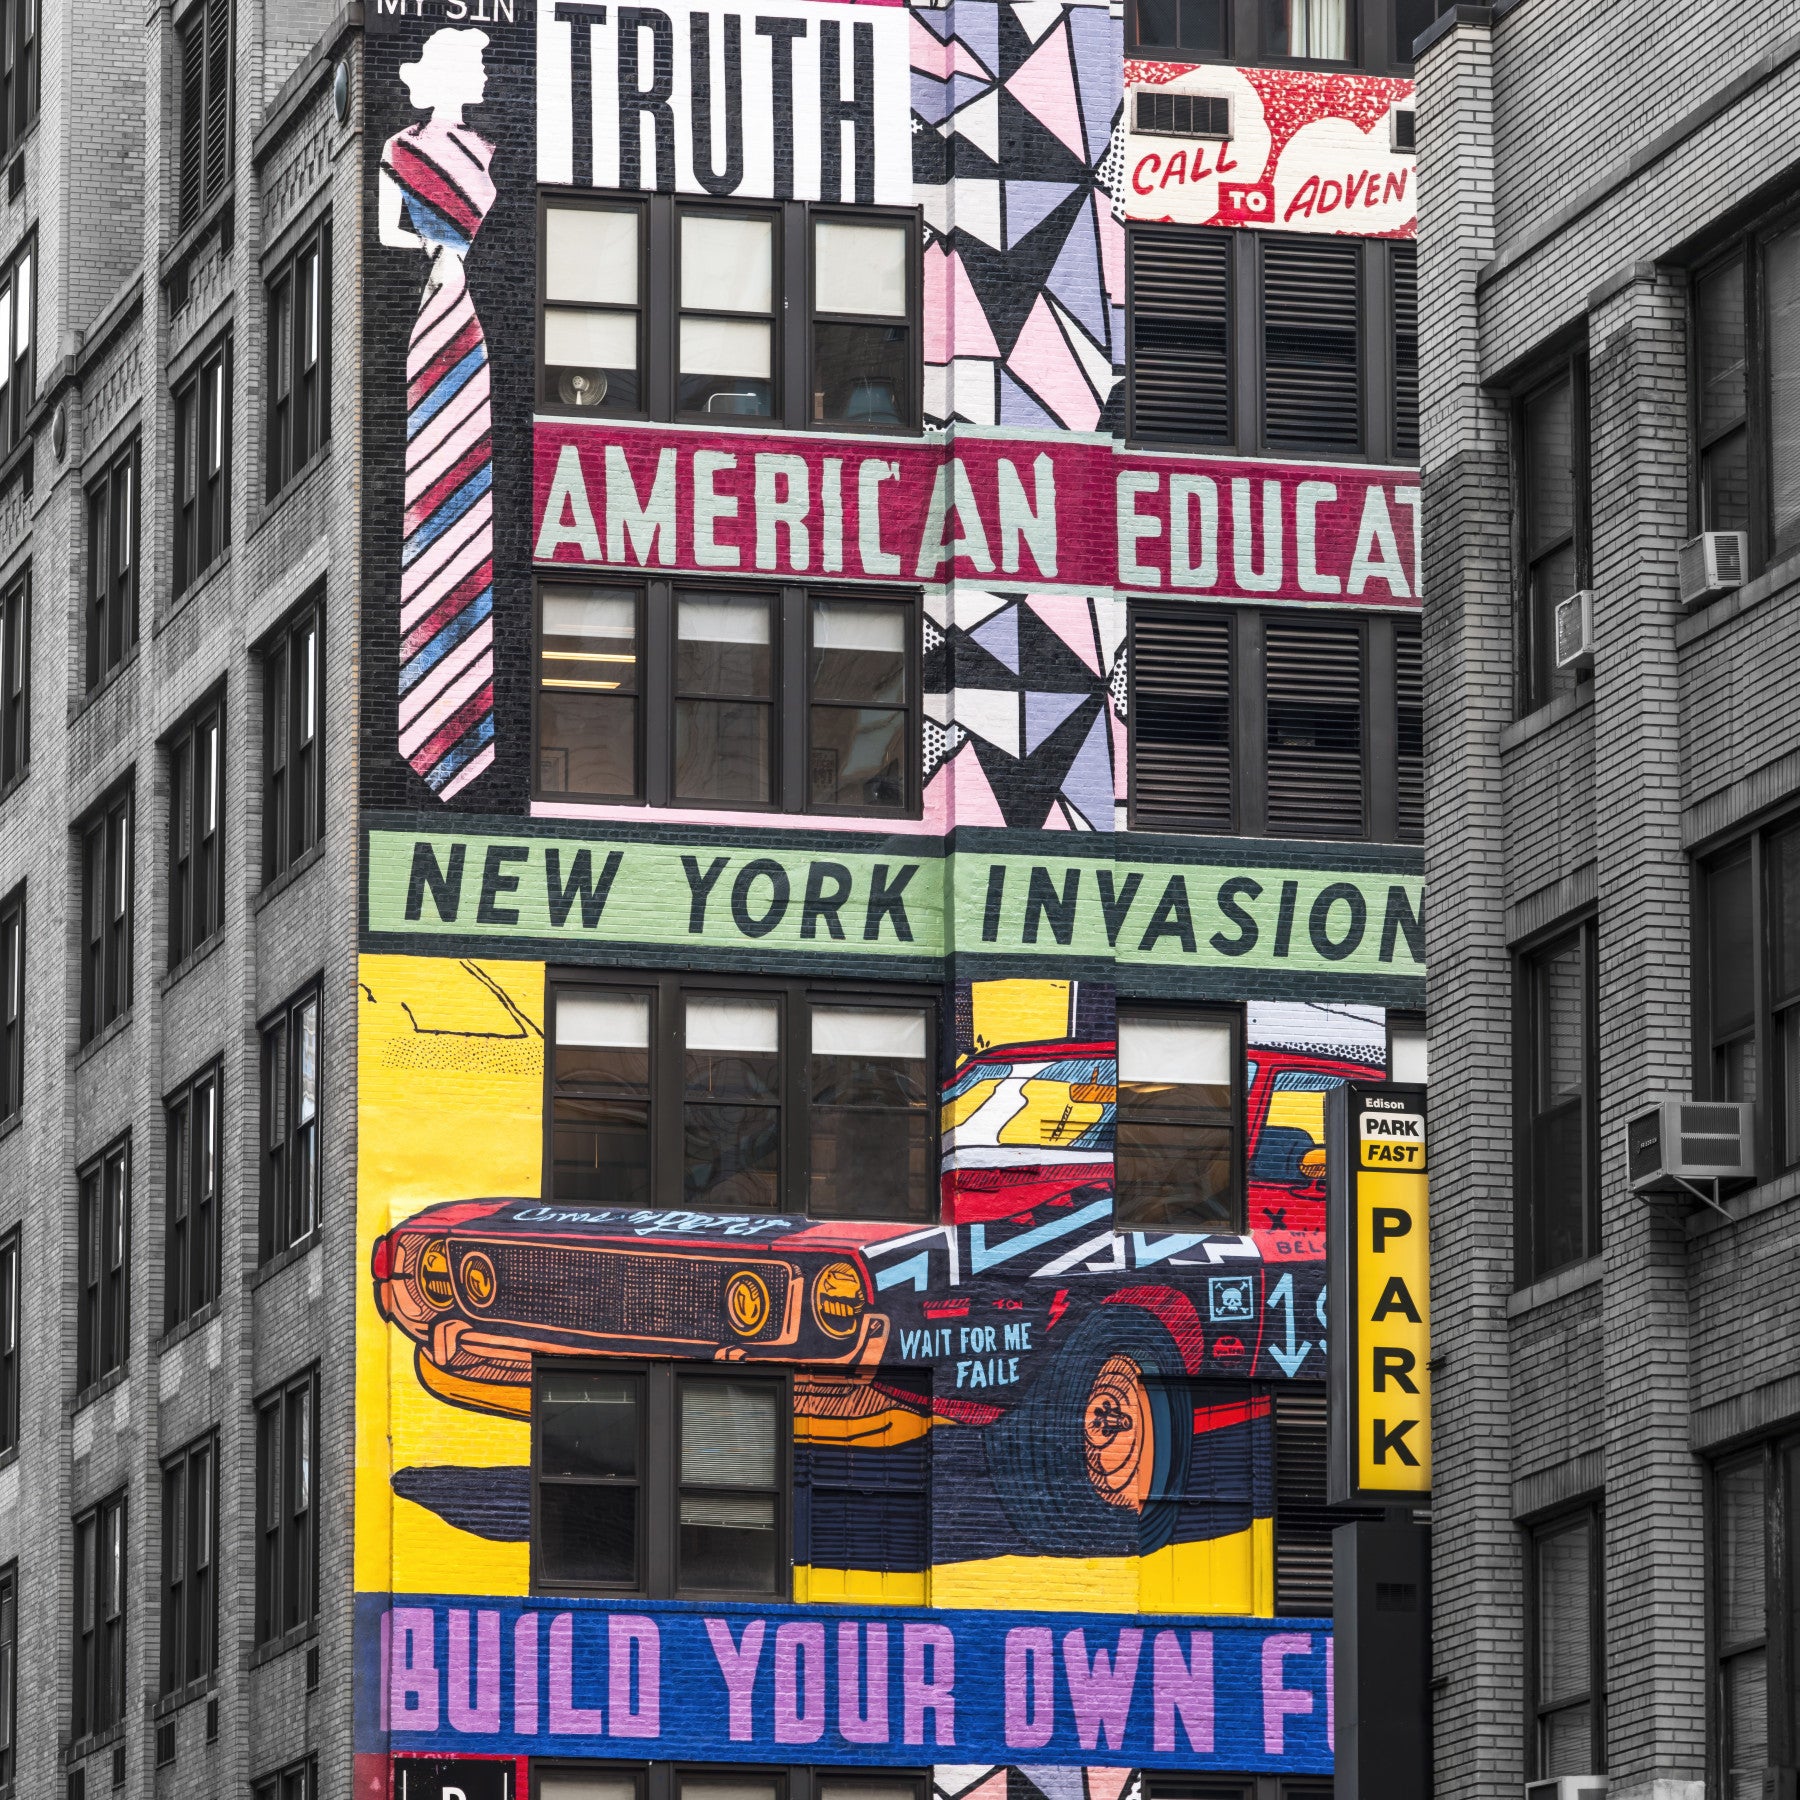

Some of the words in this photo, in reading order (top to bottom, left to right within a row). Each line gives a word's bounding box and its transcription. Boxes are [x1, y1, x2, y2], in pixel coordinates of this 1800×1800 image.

[446, 0, 514, 23] SIN
[555, 2, 874, 203] TRUTH
[1132, 141, 1238, 196] CALL
[1229, 191, 1268, 212] TO
[1284, 166, 1417, 223] ADVEN
[534, 444, 1059, 578] AMERICAN
[404, 841, 625, 929] NEW
[680, 855, 920, 942] YORK
[981, 864, 1426, 964] INVASION
[1365, 1097, 1405, 1110] Edison
[1366, 1118, 1420, 1137] PARK
[1367, 1144, 1419, 1163] FAST
[900, 1328, 952, 1360] WAIT
[960, 1325, 997, 1354] FOR
[1004, 1322, 1032, 1351] ME
[1370, 1206, 1424, 1468] PARK
[956, 1357, 1020, 1389] FAILE
[381, 1607, 660, 1739] BUILD
[703, 1618, 956, 1746] YOUR
[1004, 1627, 1215, 1753] OWN
[1262, 1633, 1334, 1755] F
